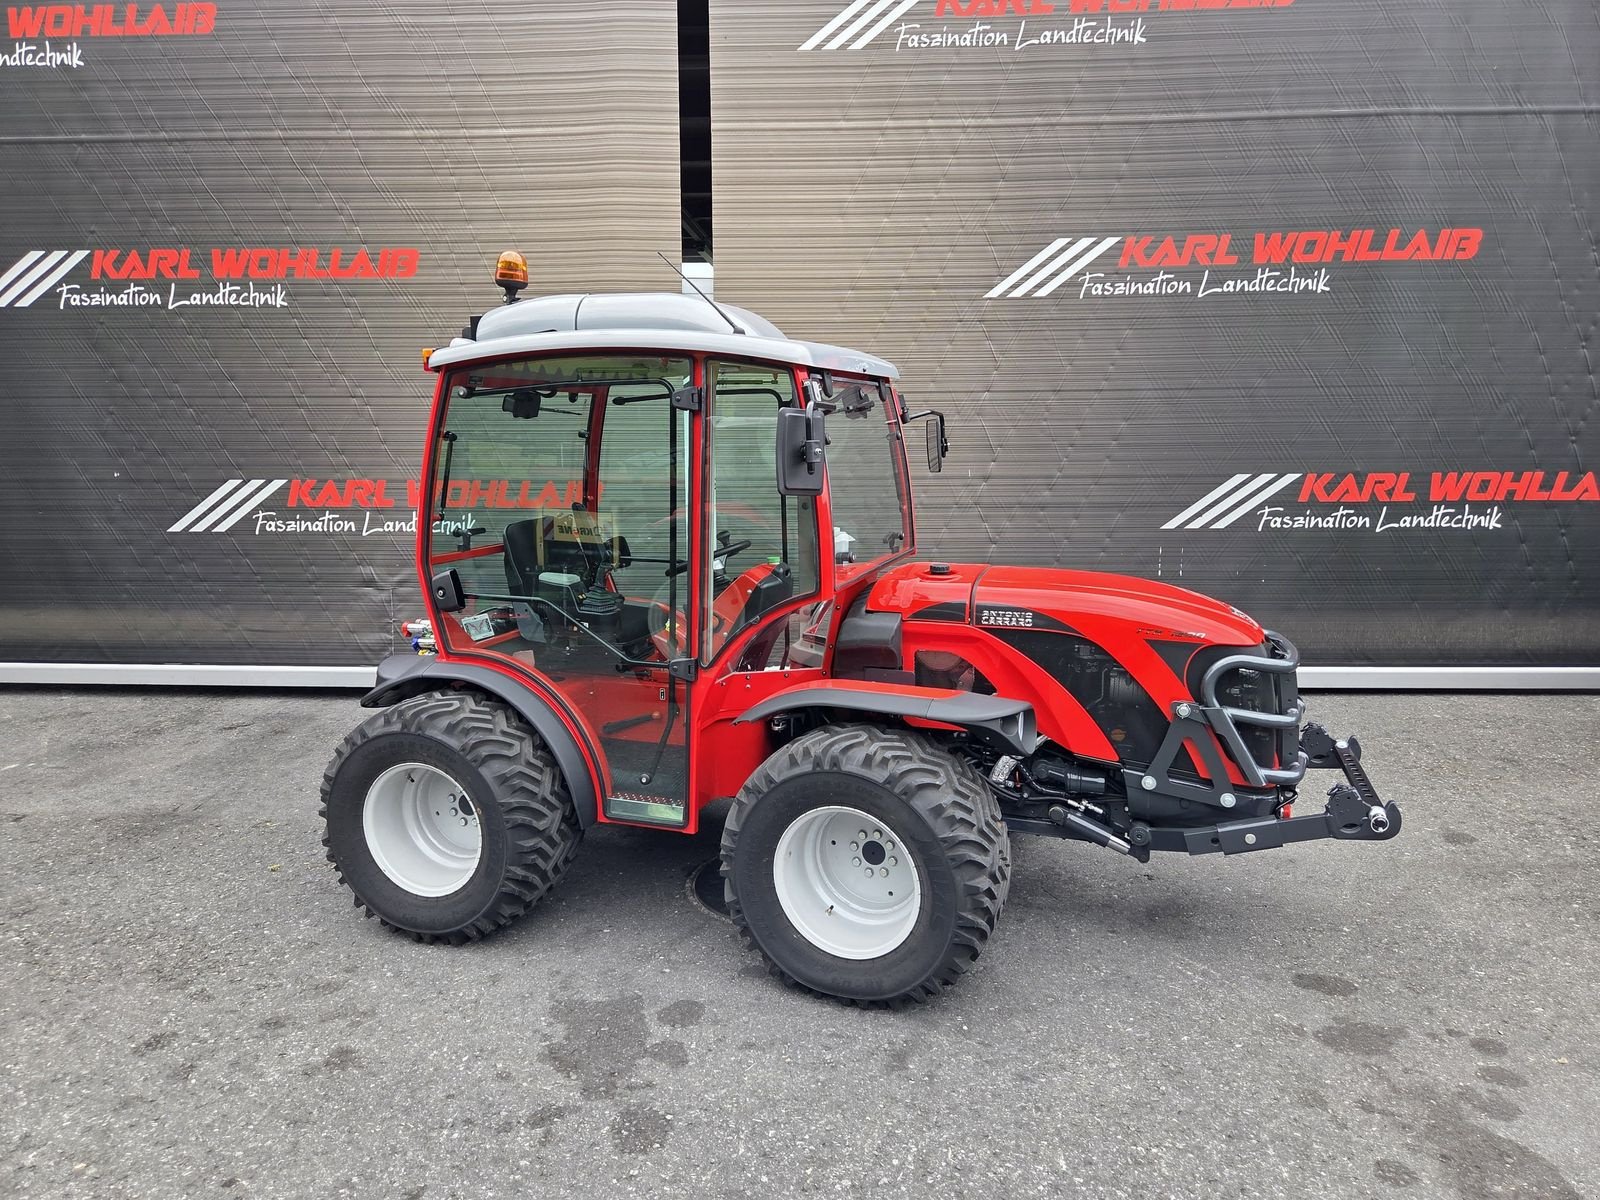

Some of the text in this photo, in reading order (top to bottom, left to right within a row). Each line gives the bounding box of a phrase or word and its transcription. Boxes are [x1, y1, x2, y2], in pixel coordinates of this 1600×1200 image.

[894, 16, 1147, 51] Faszination Landtechnik
[91, 248, 200, 280] KARL
[1119, 234, 1238, 268] KARL
[57, 281, 288, 309] Faszination Landtechnik
[1079, 266, 1330, 299] Faszination Landtechnik
[287, 479, 395, 508] KARL
[1298, 471, 1600, 503] KARL WOHLLA
[254, 510, 476, 536] Faszination Landchnik
[1256, 504, 1502, 533] Faszination Landtechnik
[981, 616, 1033, 627] CARRARO
[982, 610, 1033, 618] ANTONIO
